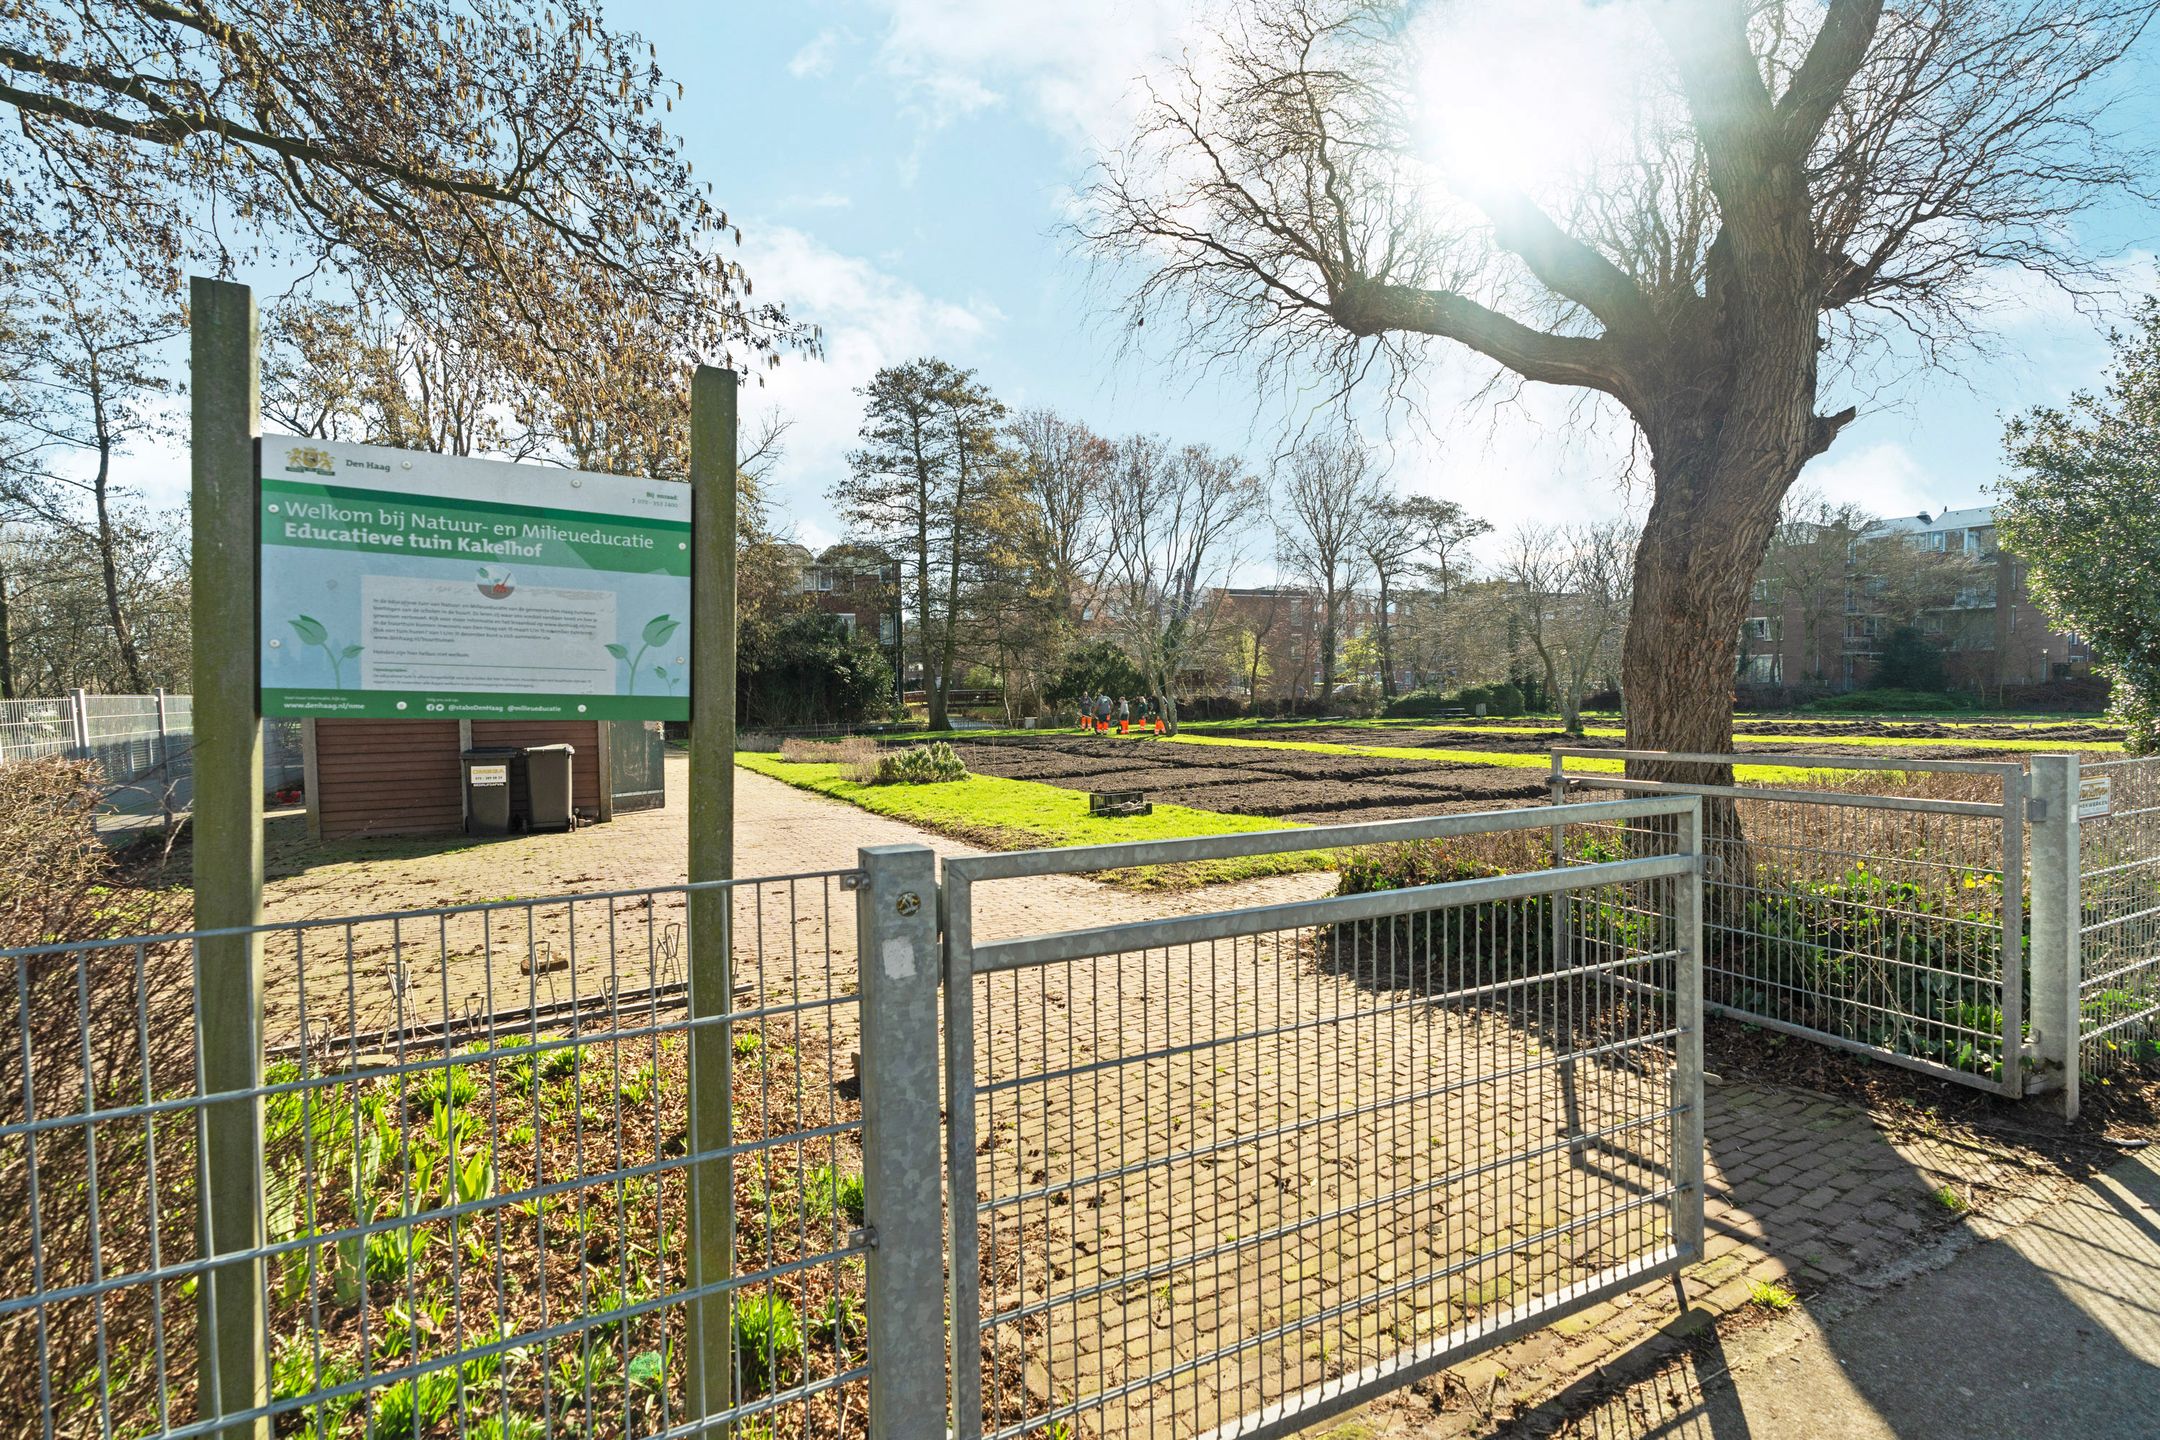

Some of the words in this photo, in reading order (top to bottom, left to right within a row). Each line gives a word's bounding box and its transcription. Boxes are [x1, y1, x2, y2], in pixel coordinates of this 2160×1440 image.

[345, 459, 364, 468] Den
[366, 461, 391, 472] Haag
[284, 501, 372, 523] Welkom
[378, 509, 405, 531] bij
[412, 514, 488, 533] Natuur-
[493, 525, 516, 537] en
[522, 524, 654, 549] Milieueducatie
[285, 522, 404, 546] Educatieve
[410, 533, 452, 550] tuin
[458, 537, 543, 558] Kakelhof
[284, 702, 365, 710] www.denhaag.nl/nme
